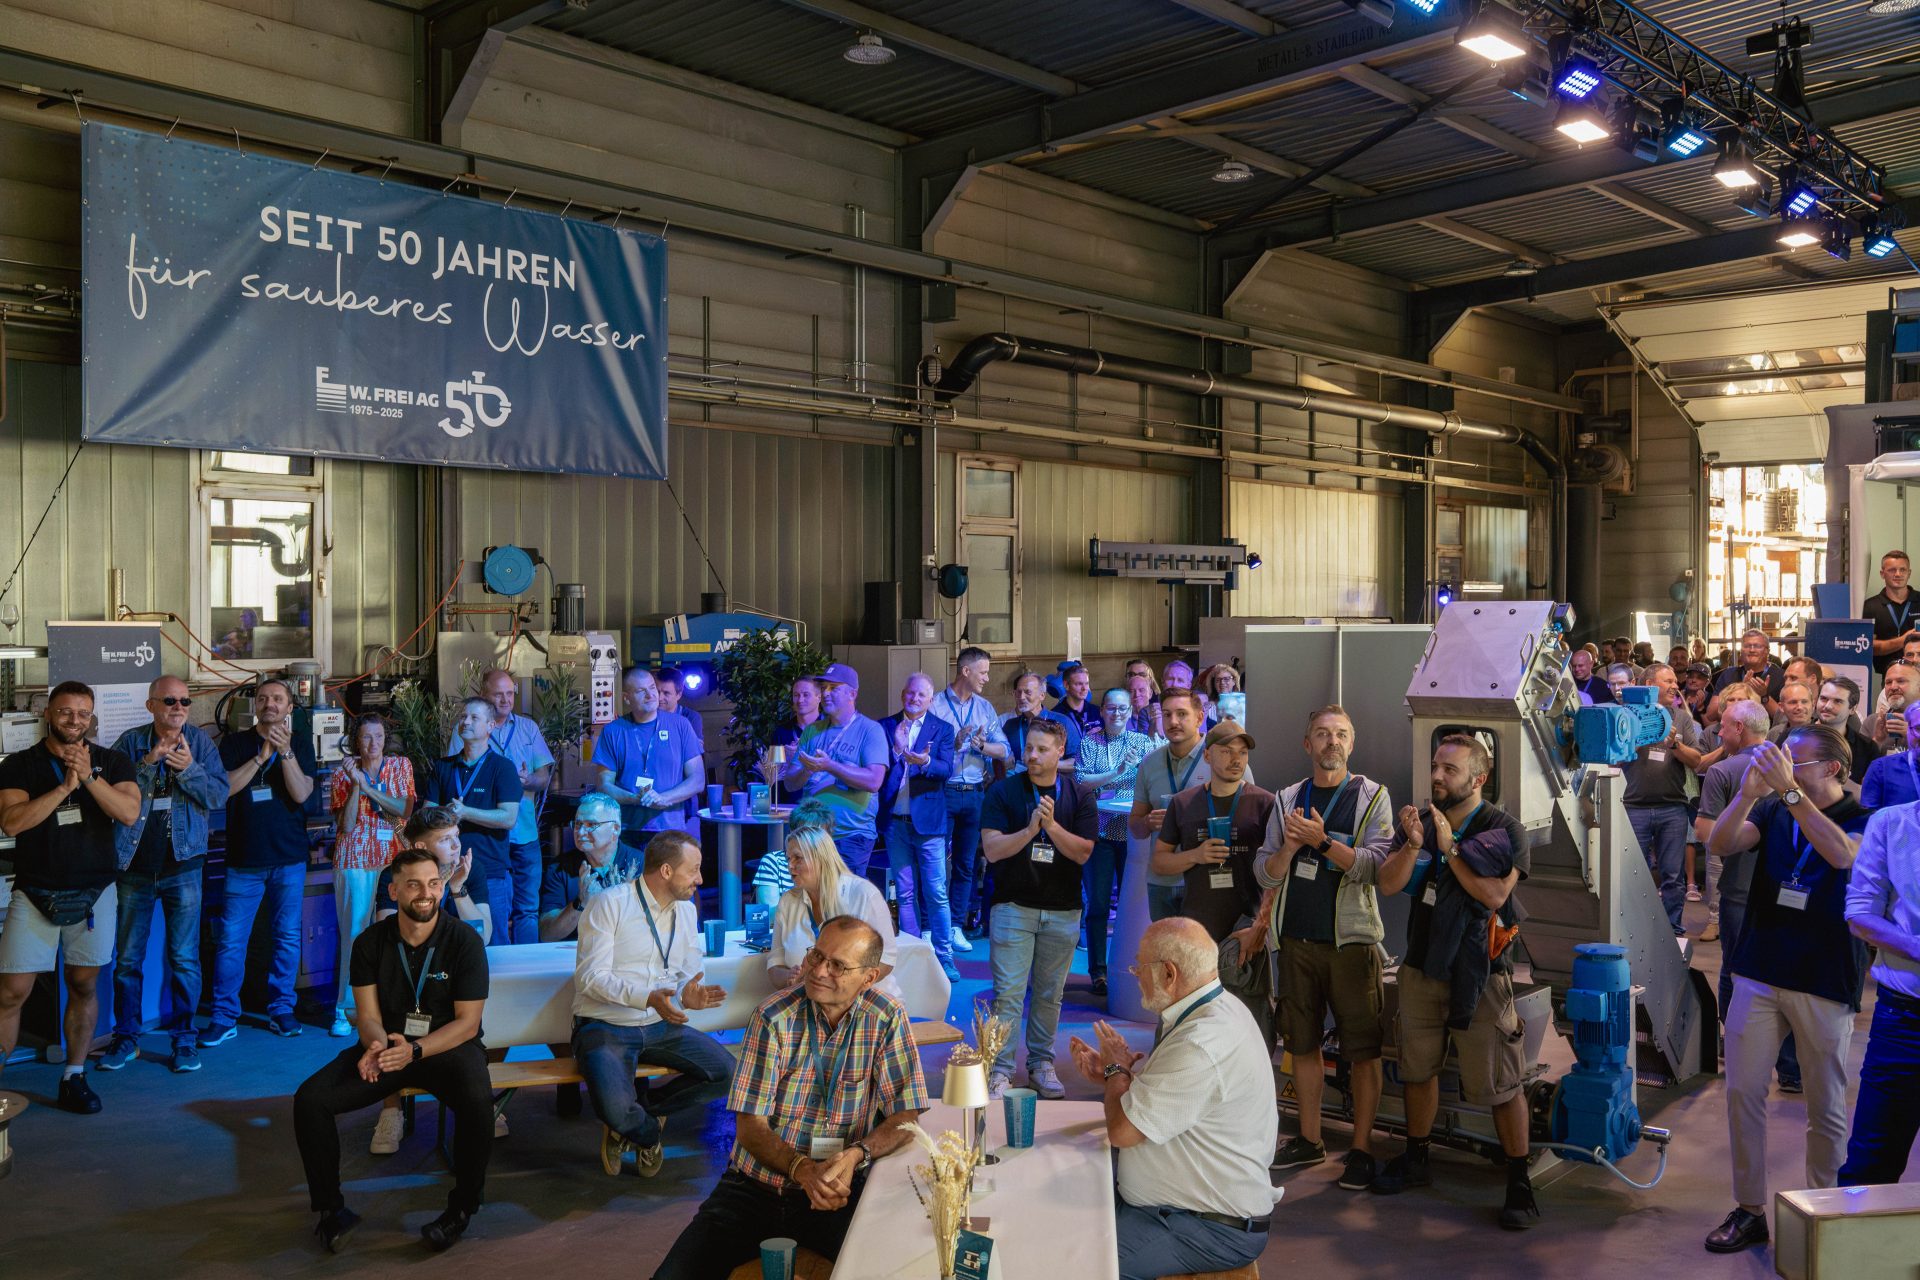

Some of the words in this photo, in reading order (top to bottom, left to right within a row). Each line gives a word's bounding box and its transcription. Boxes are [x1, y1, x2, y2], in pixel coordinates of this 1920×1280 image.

[259, 206, 362, 255] SEIT
[378, 226, 422, 265] 50
[432, 240, 576, 292] JAHREN
[126, 233, 211, 320] für
[241, 252, 453, 325] sauberes
[483, 275, 645, 356] Wasser
[350, 384, 372, 401] W.
[374, 387, 414, 405] FREI
[416, 393, 440, 408] AG
[134, 641, 156, 667] 50
[1855, 633, 1870, 653] 50
